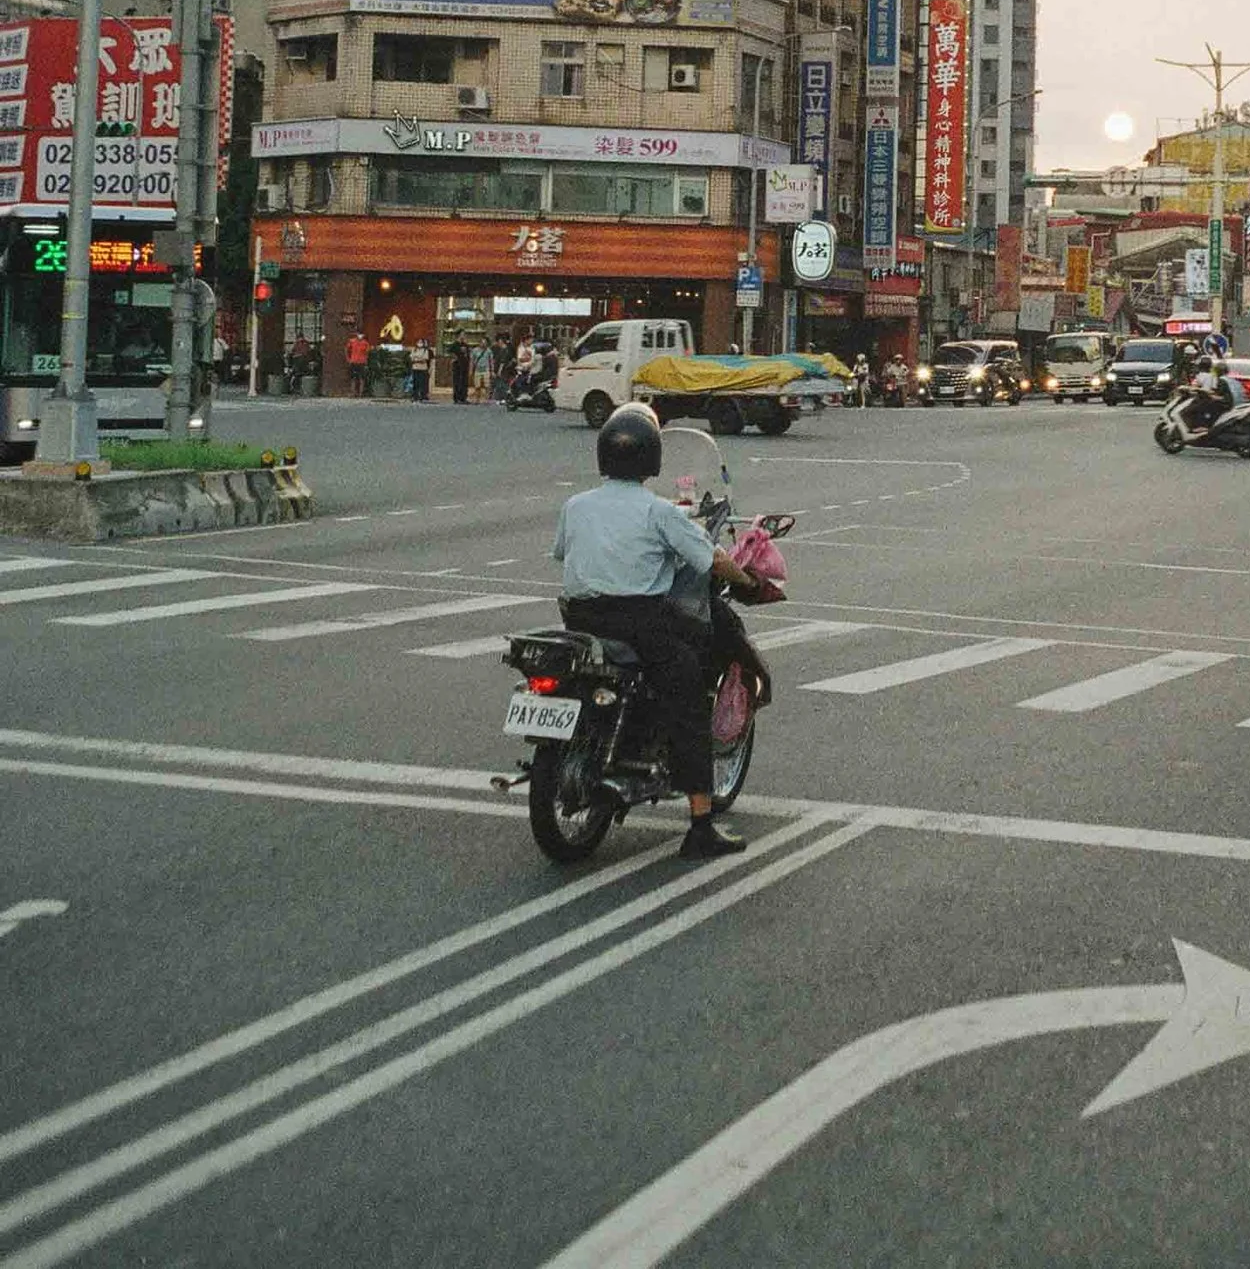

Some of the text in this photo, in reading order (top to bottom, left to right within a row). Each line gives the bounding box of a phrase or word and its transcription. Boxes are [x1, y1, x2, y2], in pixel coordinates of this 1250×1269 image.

[932, 22, 960, 227] 萬華身心精神科診所
[424, 130, 471, 152] M.P
[595, 136, 633, 156] 染髮
[639, 137, 678, 157] 599
